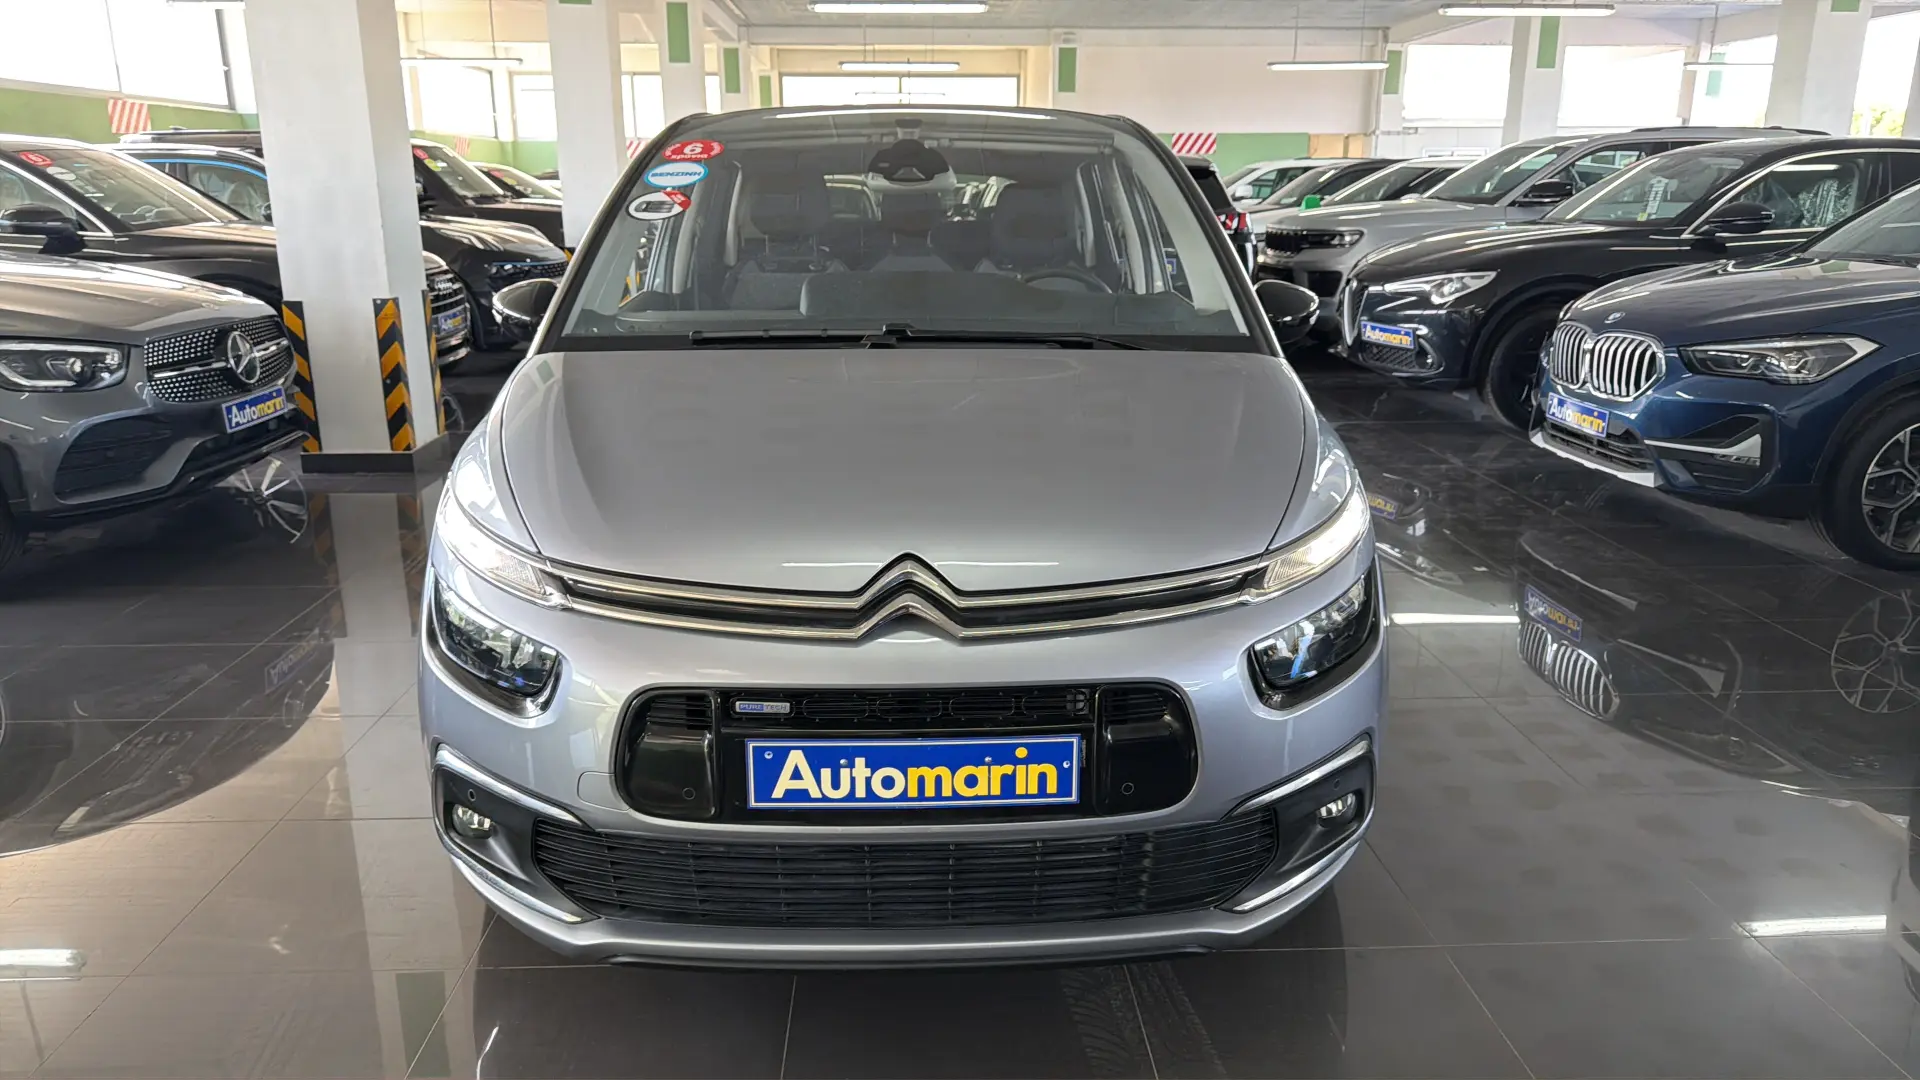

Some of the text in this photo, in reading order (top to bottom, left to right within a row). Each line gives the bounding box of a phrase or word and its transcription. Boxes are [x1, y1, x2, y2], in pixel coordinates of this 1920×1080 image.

[683, 142, 704, 155] 6
[231, 392, 284, 427] Automarin
[1549, 397, 1603, 433] Automarin
[771, 747, 1058, 799] Automarin
